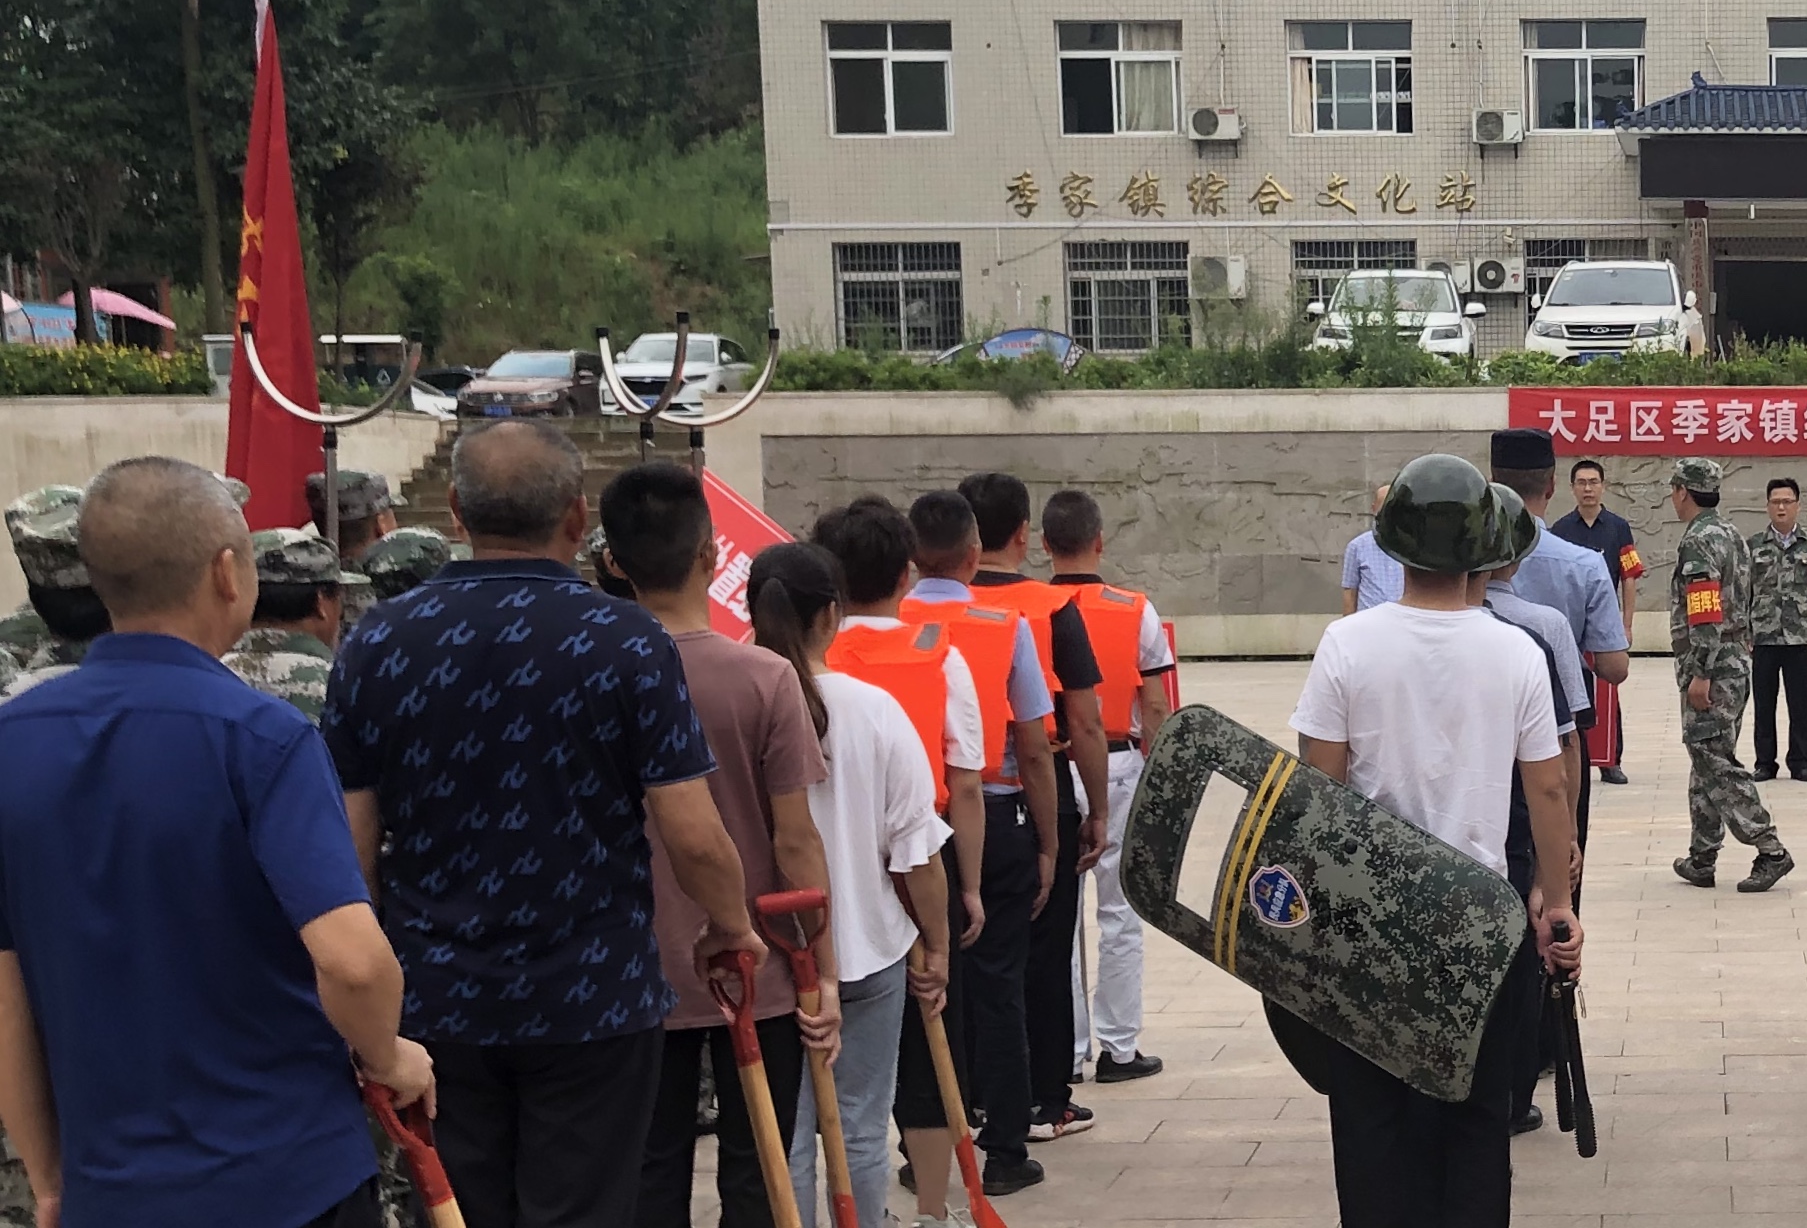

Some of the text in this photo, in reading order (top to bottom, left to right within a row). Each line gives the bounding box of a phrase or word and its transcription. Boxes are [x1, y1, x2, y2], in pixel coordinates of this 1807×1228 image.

[1006, 169, 1477, 218] 季家镇综合文化站
